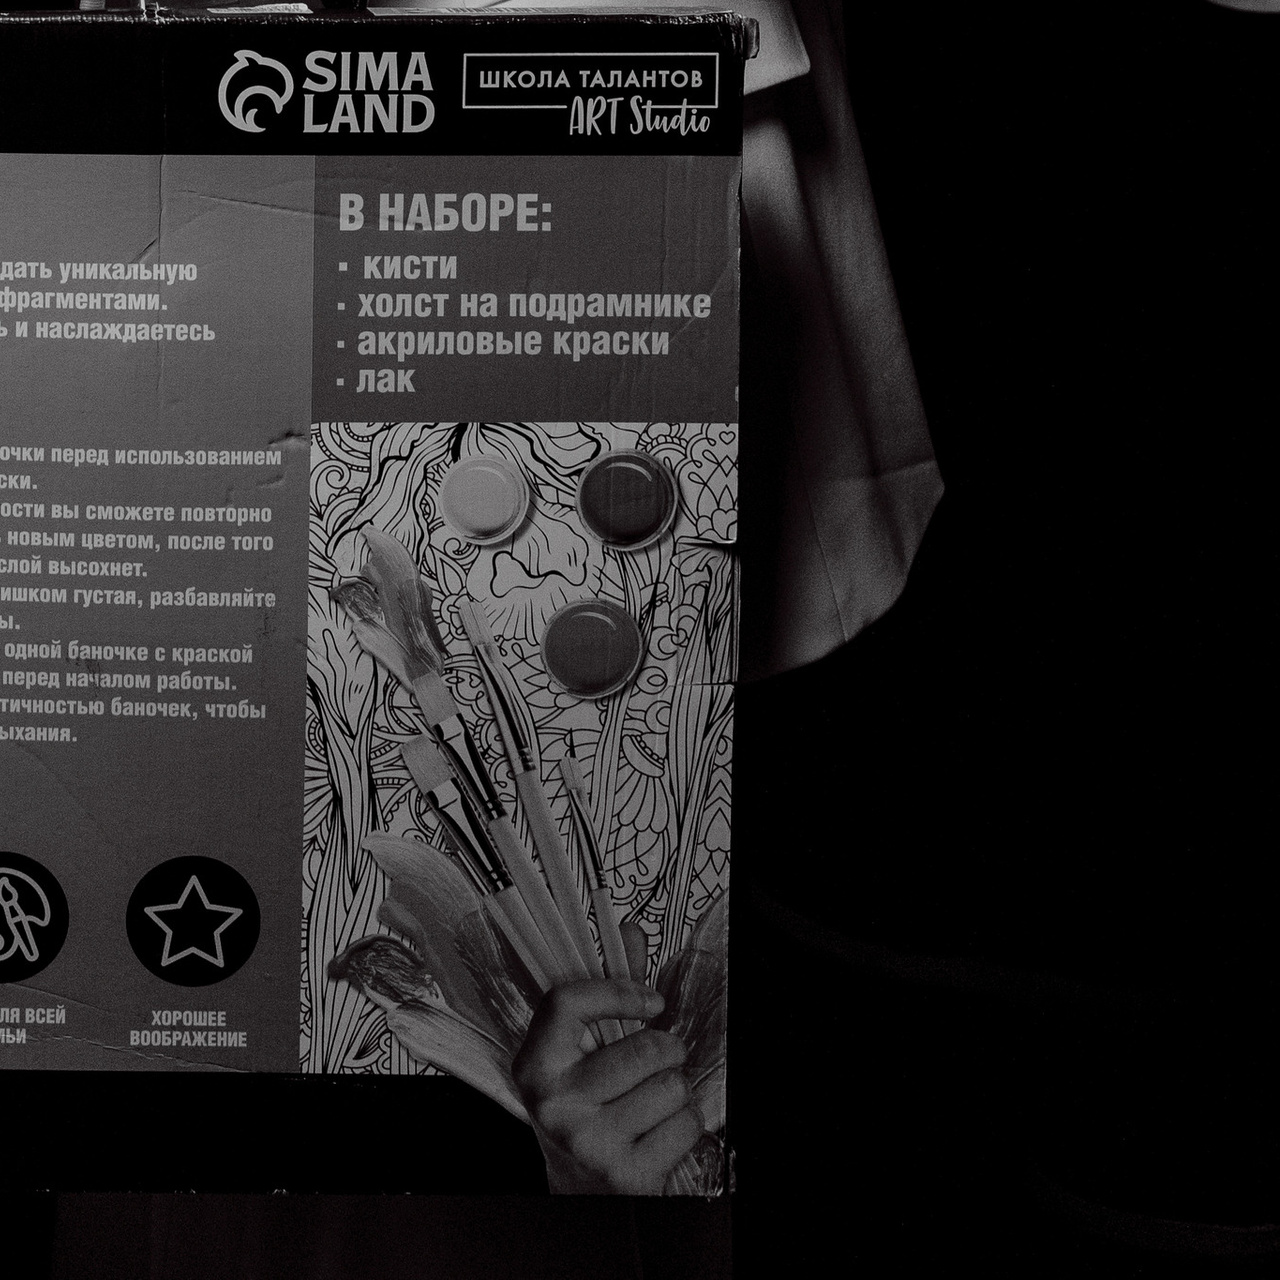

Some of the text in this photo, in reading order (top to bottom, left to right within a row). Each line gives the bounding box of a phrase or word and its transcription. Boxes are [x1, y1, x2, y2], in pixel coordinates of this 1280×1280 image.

[303, 50, 433, 93] SIMA
[480, 70, 702, 89] ШКОЛА ТАЛАНТОВ
[304, 93, 435, 133] LAND
[569, 95, 711, 137] ART Studio
[340, 193, 551, 232] В НАБОРЕ:
[60, 262, 197, 285] уникальную
[364, 255, 456, 279] кисти
[359, 293, 711, 324] холст на подрамнике
[16, 321, 27, 338] и
[36, 321, 215, 343] наслаждаетесь
[358, 330, 669, 362] акриловые краски
[357, 369, 415, 393] лак
[52, 447, 109, 467] перед
[115, 449, 281, 466] использованием
[52, 504, 79, 519] вы
[86, 505, 174, 522] сможете
[182, 506, 271, 526] повторно
[8, 531, 74, 547] новым
[82, 533, 160, 552] цветом,
[168, 535, 225, 551] после
[232, 535, 273, 551] того
[49, 560, 147, 577] высохнет.
[111, 696, 197, 721] баночек,
[205, 699, 265, 719] чтобы
[25, 1005, 65, 1024] ВСЕЙ
[152, 1010, 226, 1027] ХОРОШЕЕ
[130, 1030, 246, 1048] ВООБРАЖЕНИЕ
